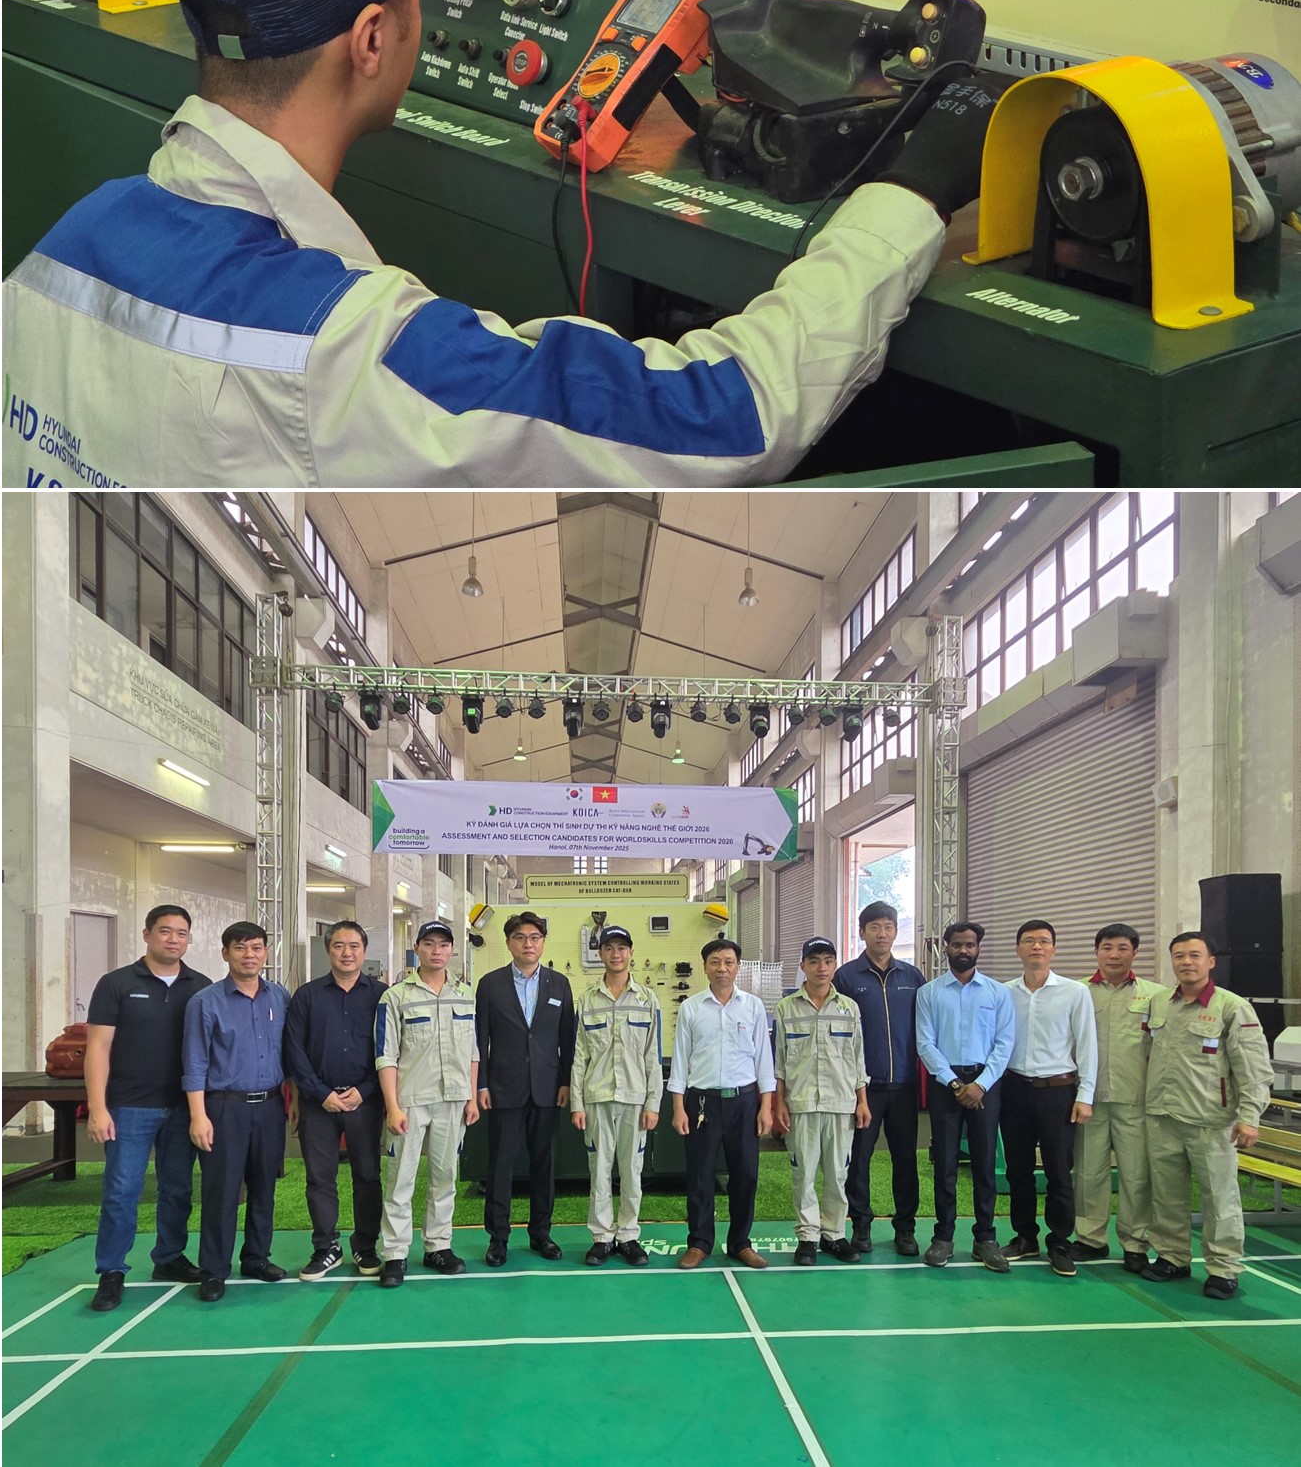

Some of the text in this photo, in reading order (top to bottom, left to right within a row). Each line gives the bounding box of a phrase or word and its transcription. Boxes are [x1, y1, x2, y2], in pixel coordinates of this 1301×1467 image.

[447, 6, 463, 19] Switch
[515, 58, 527, 66] STOP
[488, 72, 507, 86] Operator
[931, 99, 967, 115] N518
[407, 115, 510, 147] Switch Board
[628, 170, 738, 206] Transmission
[652, 197, 712, 216] Lever
[965, 288, 1080, 324] Alternator
[10, 394, 38, 441] HD
[43, 414, 81, 454] HYUNDAI
[130, 687, 152, 709] TRUCK
[499, 807, 512, 815] HD
[573, 808, 598, 817] KOICA
[478, 820, 498, 828] ĐÁNH
[500, 820, 512, 828] GIÁ
[565, 822, 582, 830] SINH
[552, 835, 598, 843] CANDIDATES
[584, 844, 614, 852] November
